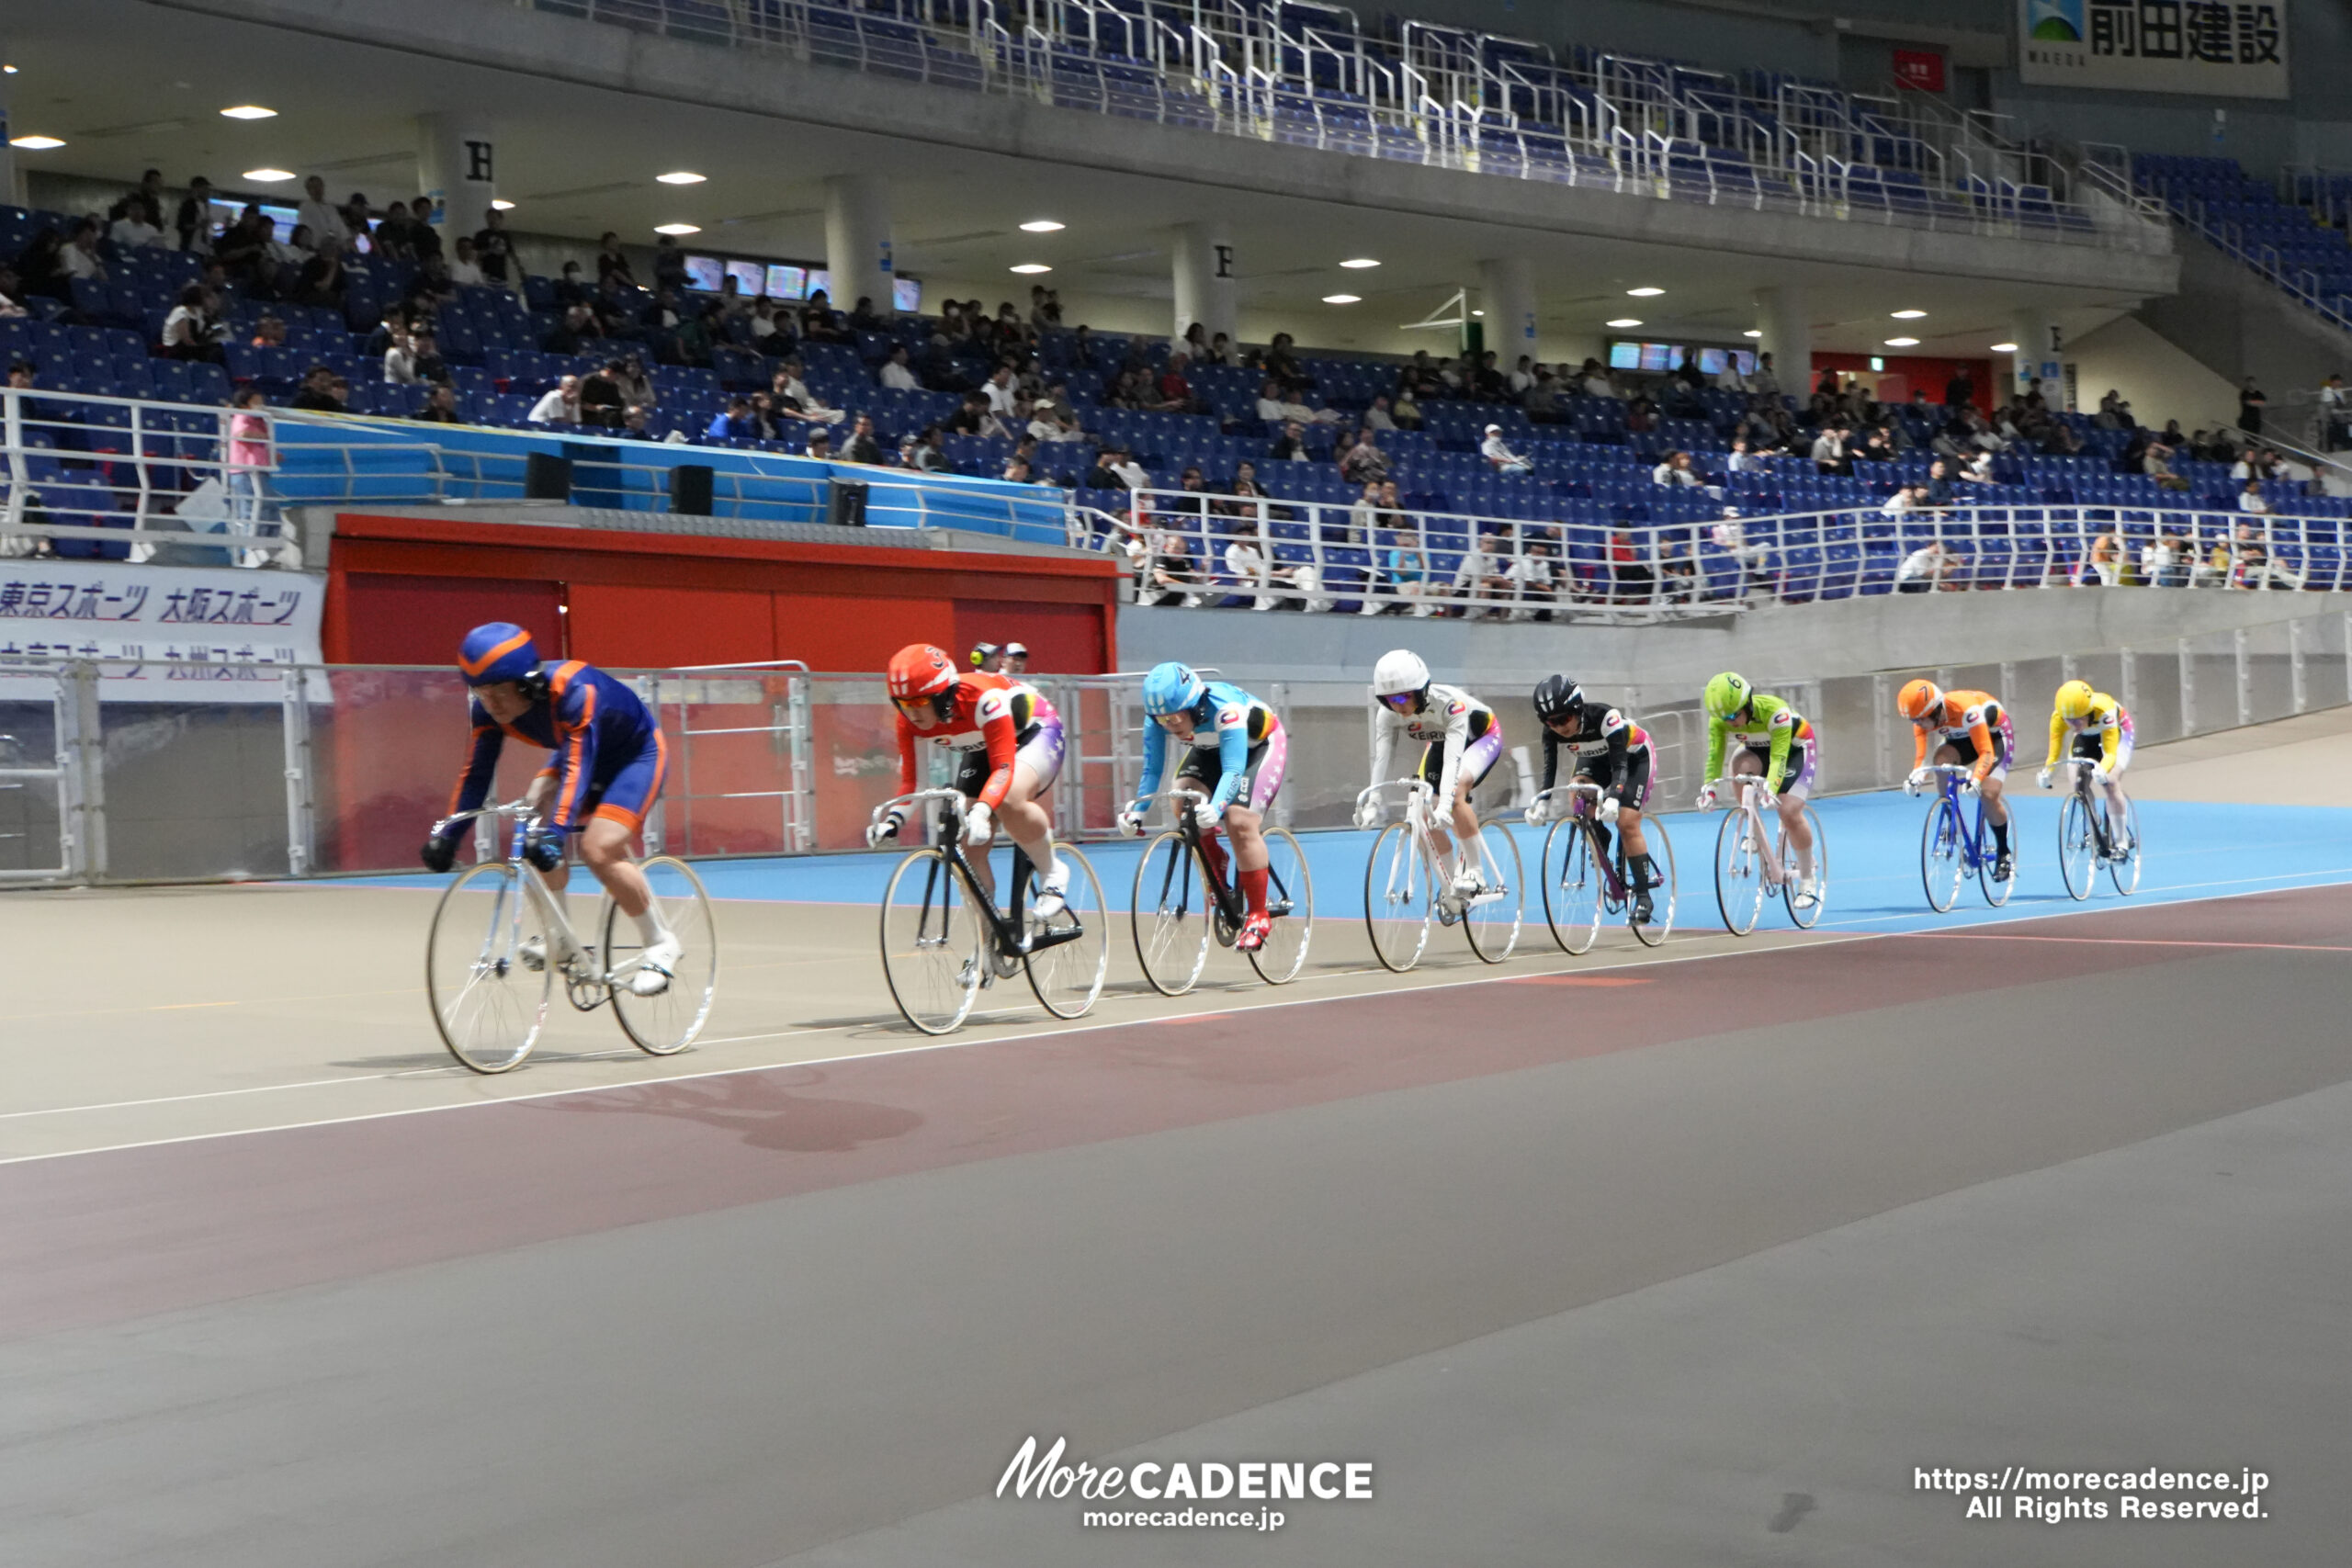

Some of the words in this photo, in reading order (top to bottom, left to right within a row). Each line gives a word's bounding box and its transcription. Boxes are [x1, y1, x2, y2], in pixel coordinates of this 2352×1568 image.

[2090, 0, 2281, 64] 前田建設
[464, 140, 492, 182] H
[0, 581, 150, 620] 東京スポーツ
[159, 586, 302, 625] 大阪スポーツ
[925, 645, 945, 670] 3
[1175, 665, 1192, 685] 4
[1918, 685, 1928, 702] 7
